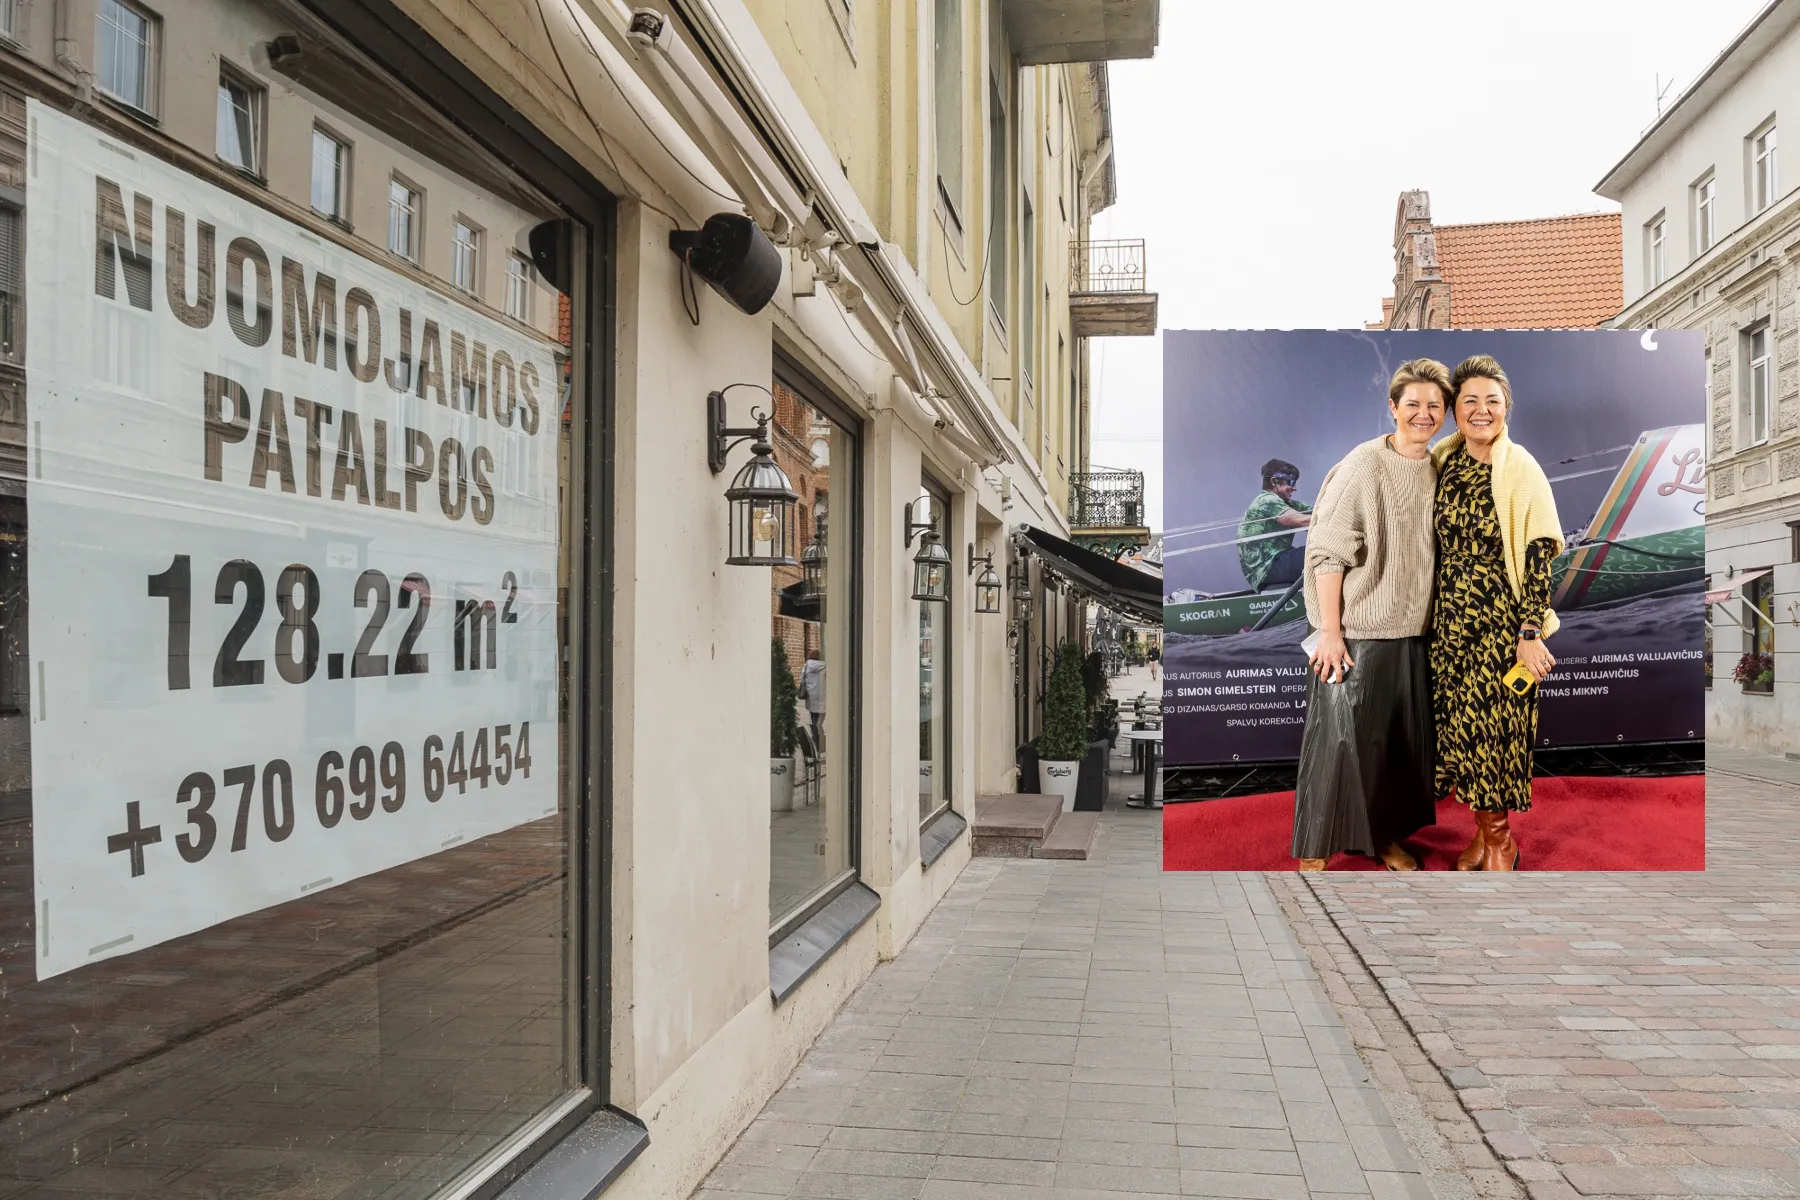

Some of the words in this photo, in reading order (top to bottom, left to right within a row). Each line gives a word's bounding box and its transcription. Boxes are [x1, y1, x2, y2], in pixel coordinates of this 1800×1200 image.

[95, 176, 540, 437] NUOMOJAMOS
[203, 371, 495, 527] PATALPOS
[148, 555, 430, 691] 128.22
[1591, 653, 1635, 664] AURIMAS
[1636, 649, 1704, 661] VALUJAVIČIUS
[1179, 671, 1222, 680] AUTORIUS
[1225, 668, 1273, 679] AURIMAS
[1573, 668, 1639, 680] VALUJAVIČIUS
[1177, 687, 1212, 697] SIMON
[1214, 684, 1276, 695] GIMELSTEIN
[1572, 686, 1609, 696] MIKNYS
[1249, 701, 1291, 710] KOMANDA
[1226, 718, 1258, 727] SPALVŲ
[1259, 716, 1305, 726] KOREKCIJA
[107, 757, 296, 878] +370
[315, 741, 408, 830] 699
[422, 721, 533, 804] 64454
